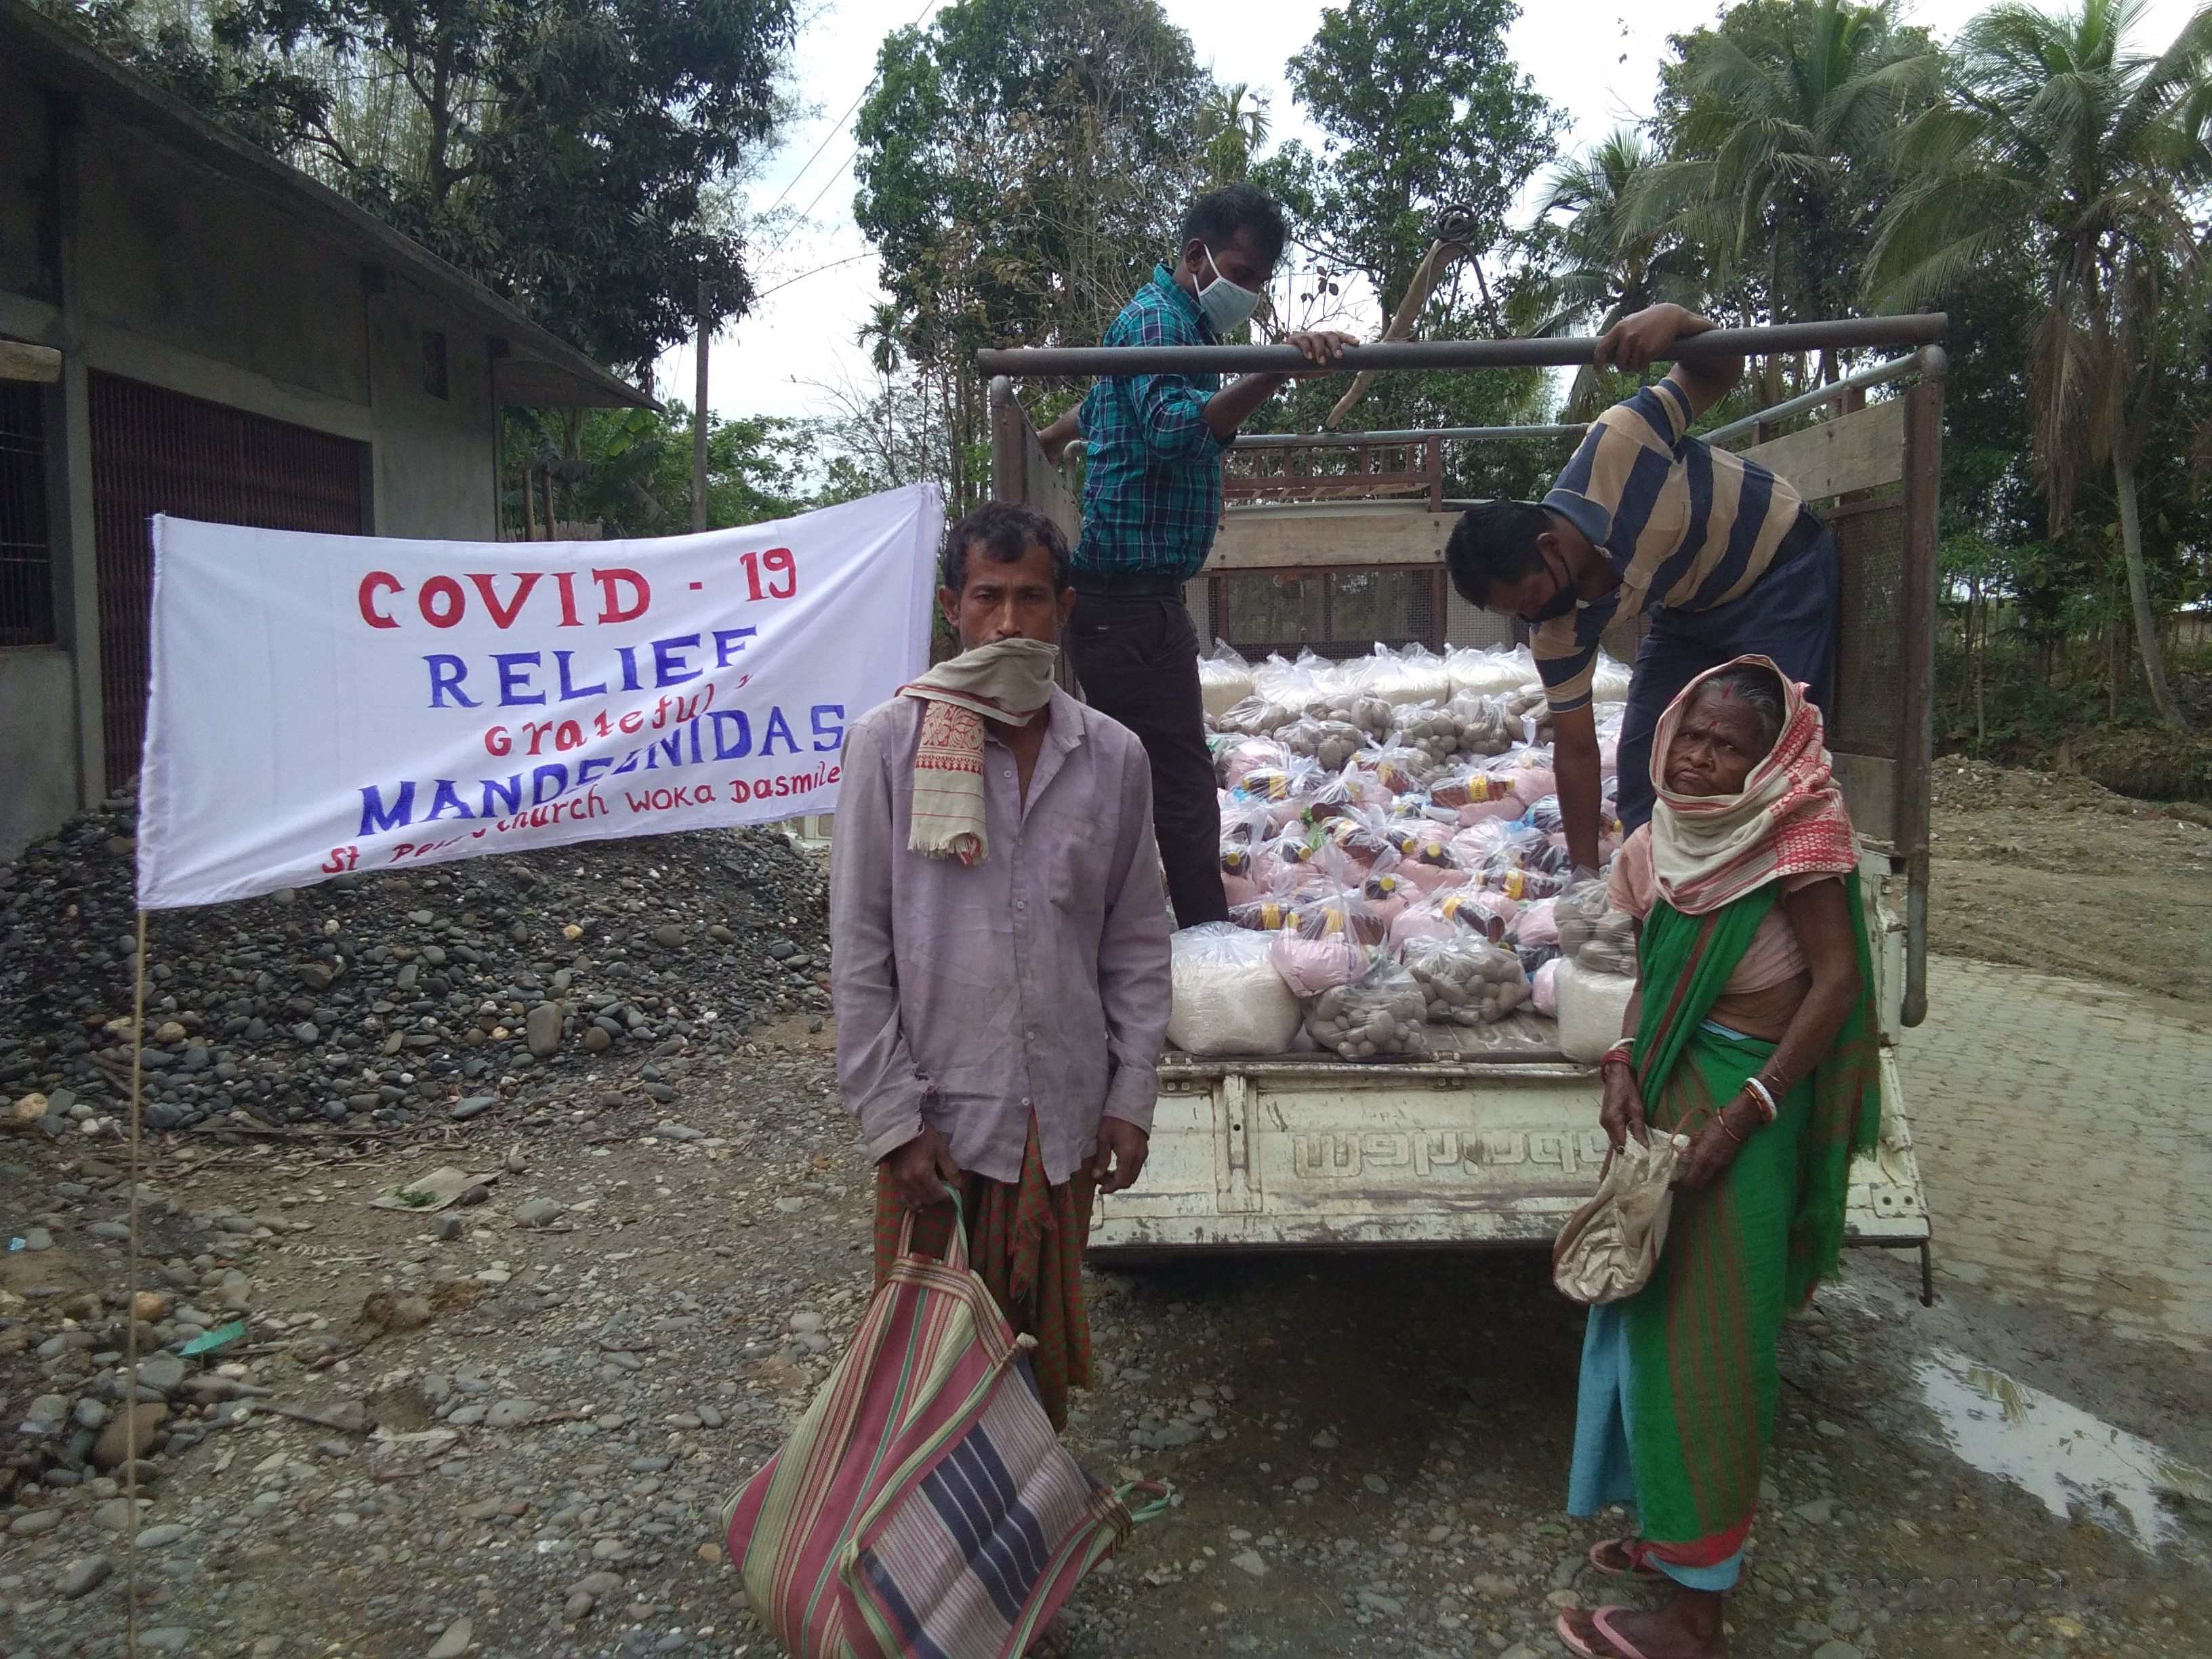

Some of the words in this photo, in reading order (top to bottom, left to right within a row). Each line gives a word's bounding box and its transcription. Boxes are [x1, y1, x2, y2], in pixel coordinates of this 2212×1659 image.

[358, 567, 651, 630] COVID
[740, 547, 797, 602] 19
[421, 625, 758, 708] RELIEF
[321, 845, 361, 874] St
